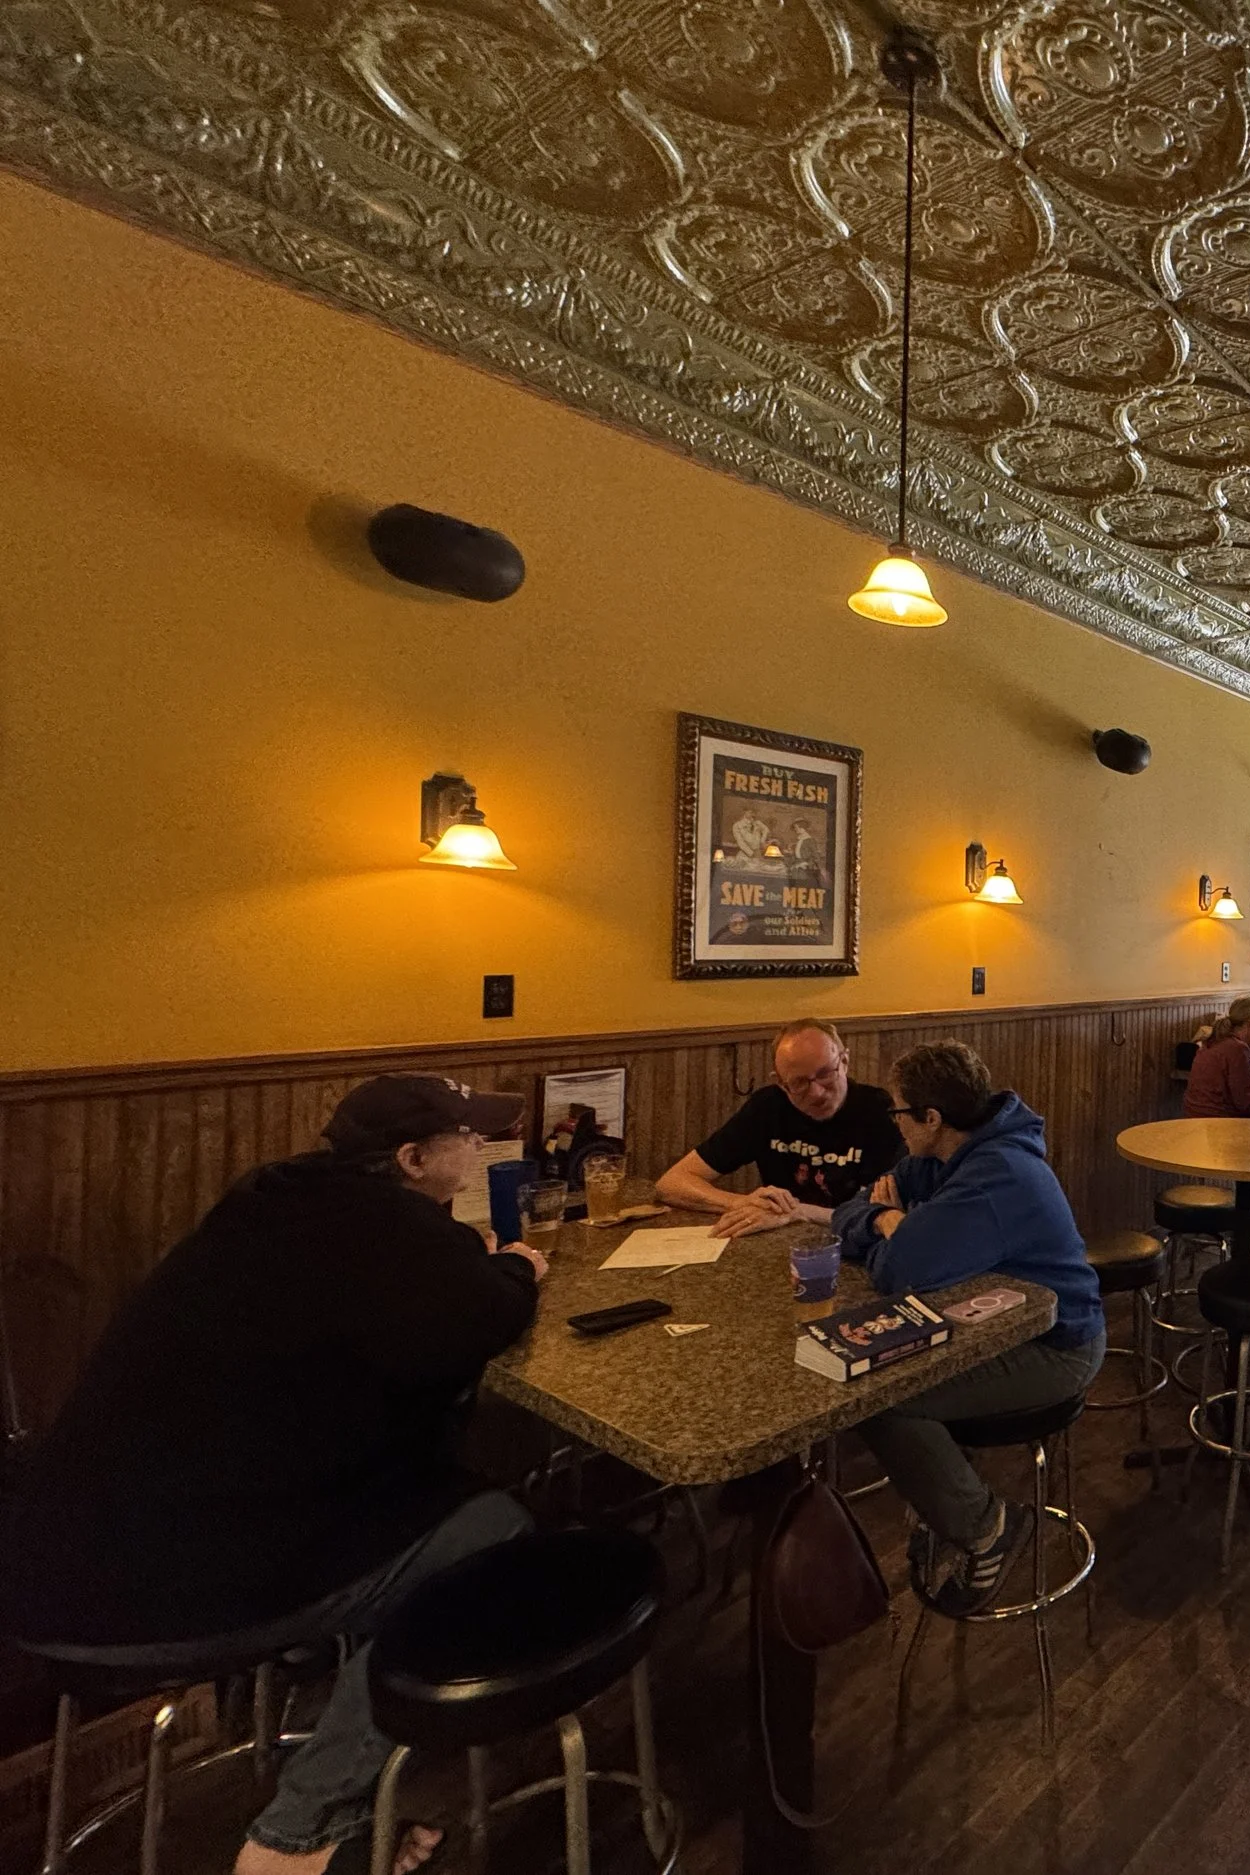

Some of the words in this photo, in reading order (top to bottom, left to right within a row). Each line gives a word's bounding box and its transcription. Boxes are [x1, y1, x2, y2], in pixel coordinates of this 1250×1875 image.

[761, 764, 795, 779] BUY
[724, 769, 783, 797] FRESH
[787, 779, 829, 804] FISH
[720, 881, 765, 907] SAVE
[765, 891, 782, 902] the
[783, 886, 826, 909] MEAT
[764, 926, 787, 936] and
